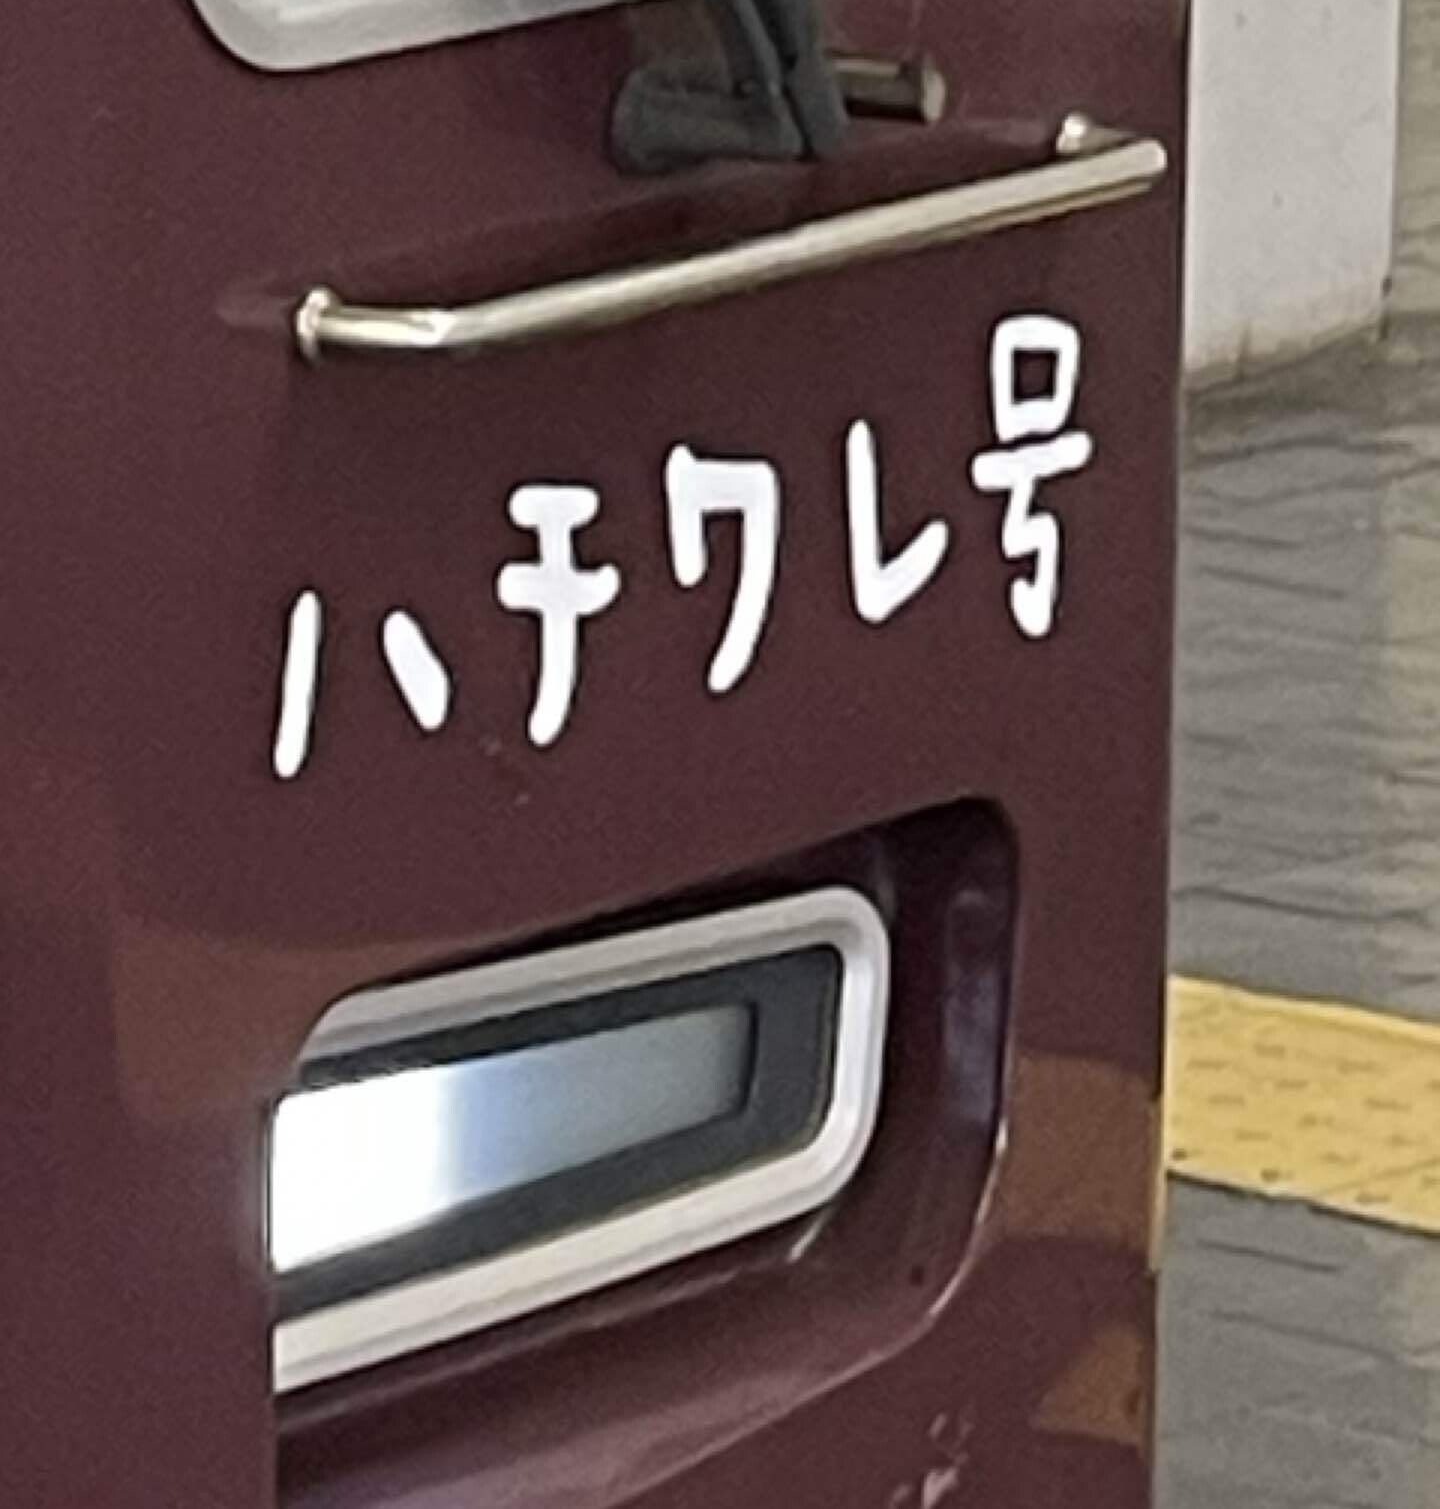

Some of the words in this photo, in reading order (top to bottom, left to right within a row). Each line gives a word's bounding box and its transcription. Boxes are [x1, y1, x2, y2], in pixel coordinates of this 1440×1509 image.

[272, 313, 1093, 779] ハチワレ号
